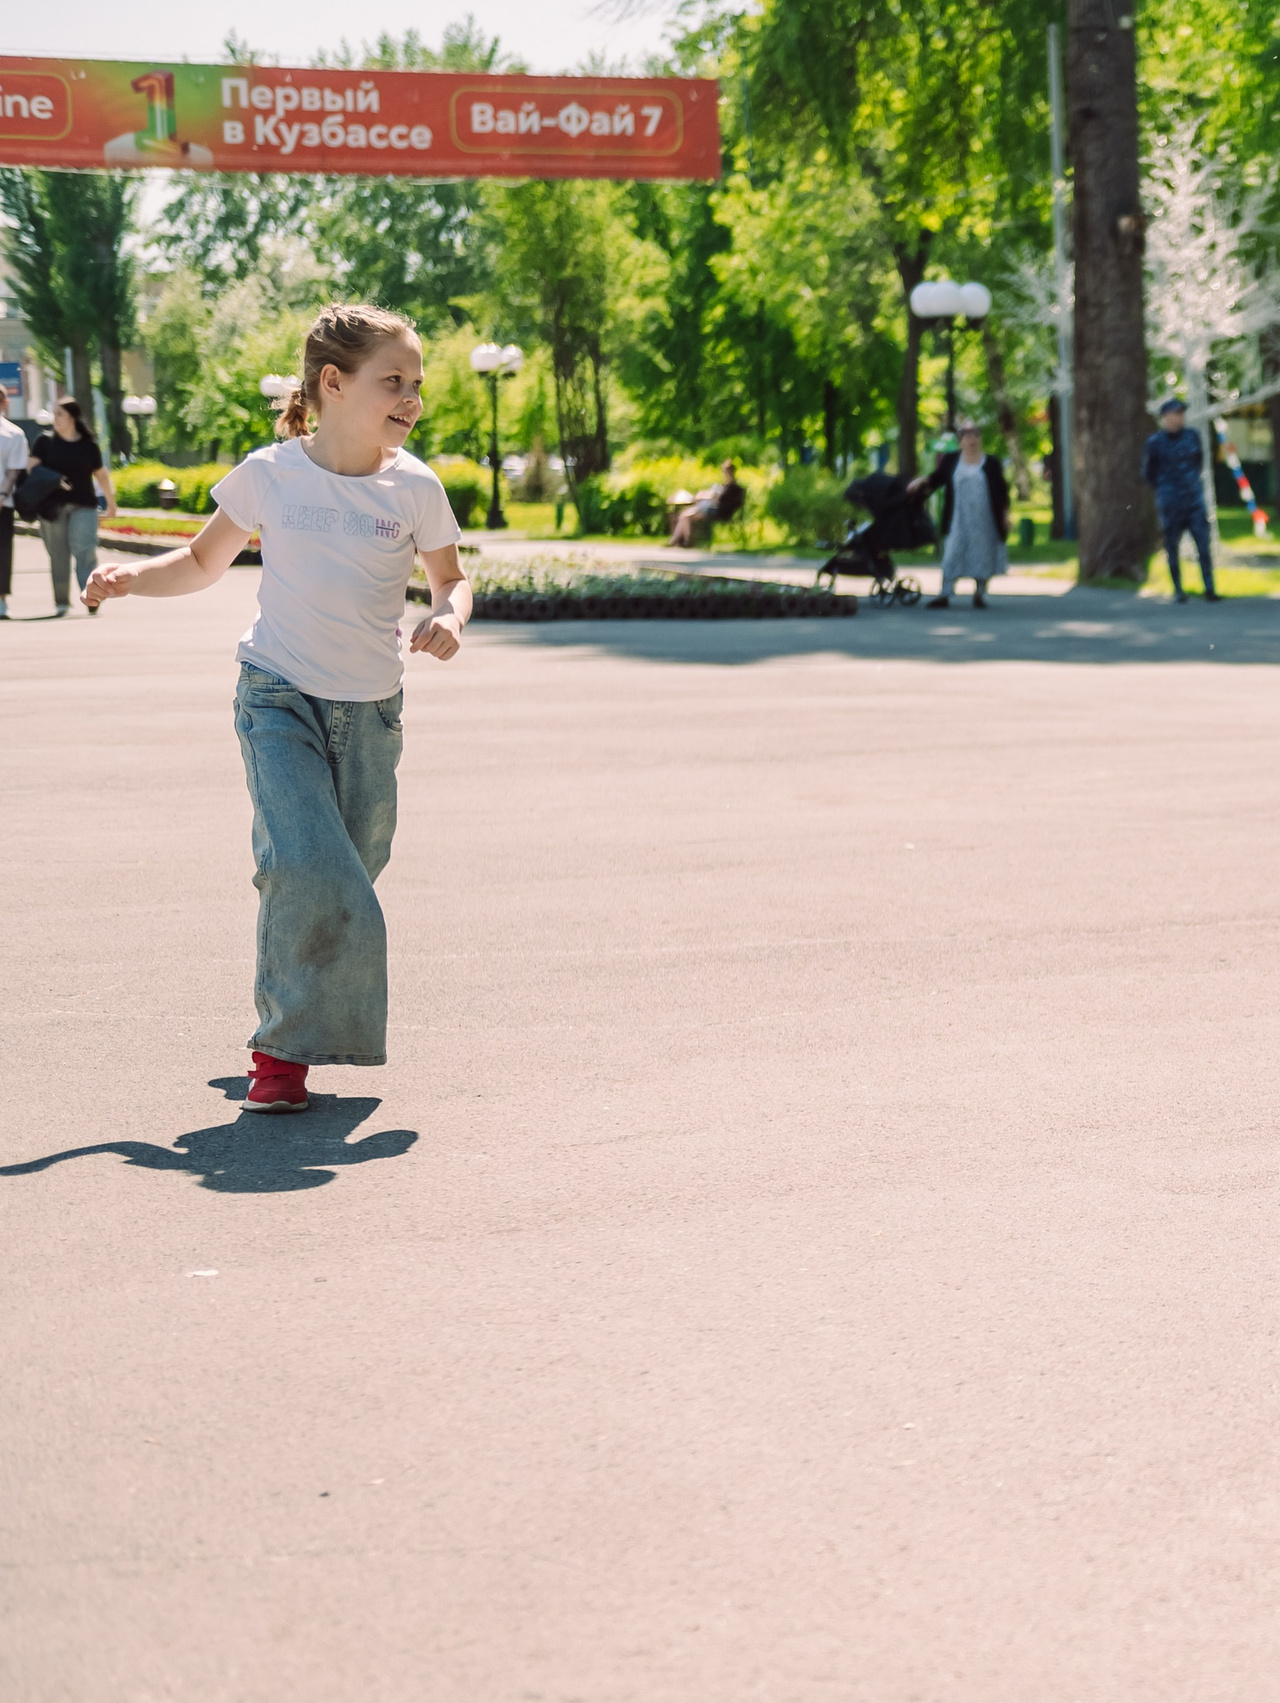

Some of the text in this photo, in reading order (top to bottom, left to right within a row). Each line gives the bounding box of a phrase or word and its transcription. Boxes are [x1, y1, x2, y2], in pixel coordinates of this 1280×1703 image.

[221, 77, 380, 118] Первый
[222, 113, 433, 155] в Кузбассе
[470, 101, 664, 138] Вай-Фай 7
[281, 503, 340, 533] KEEP
